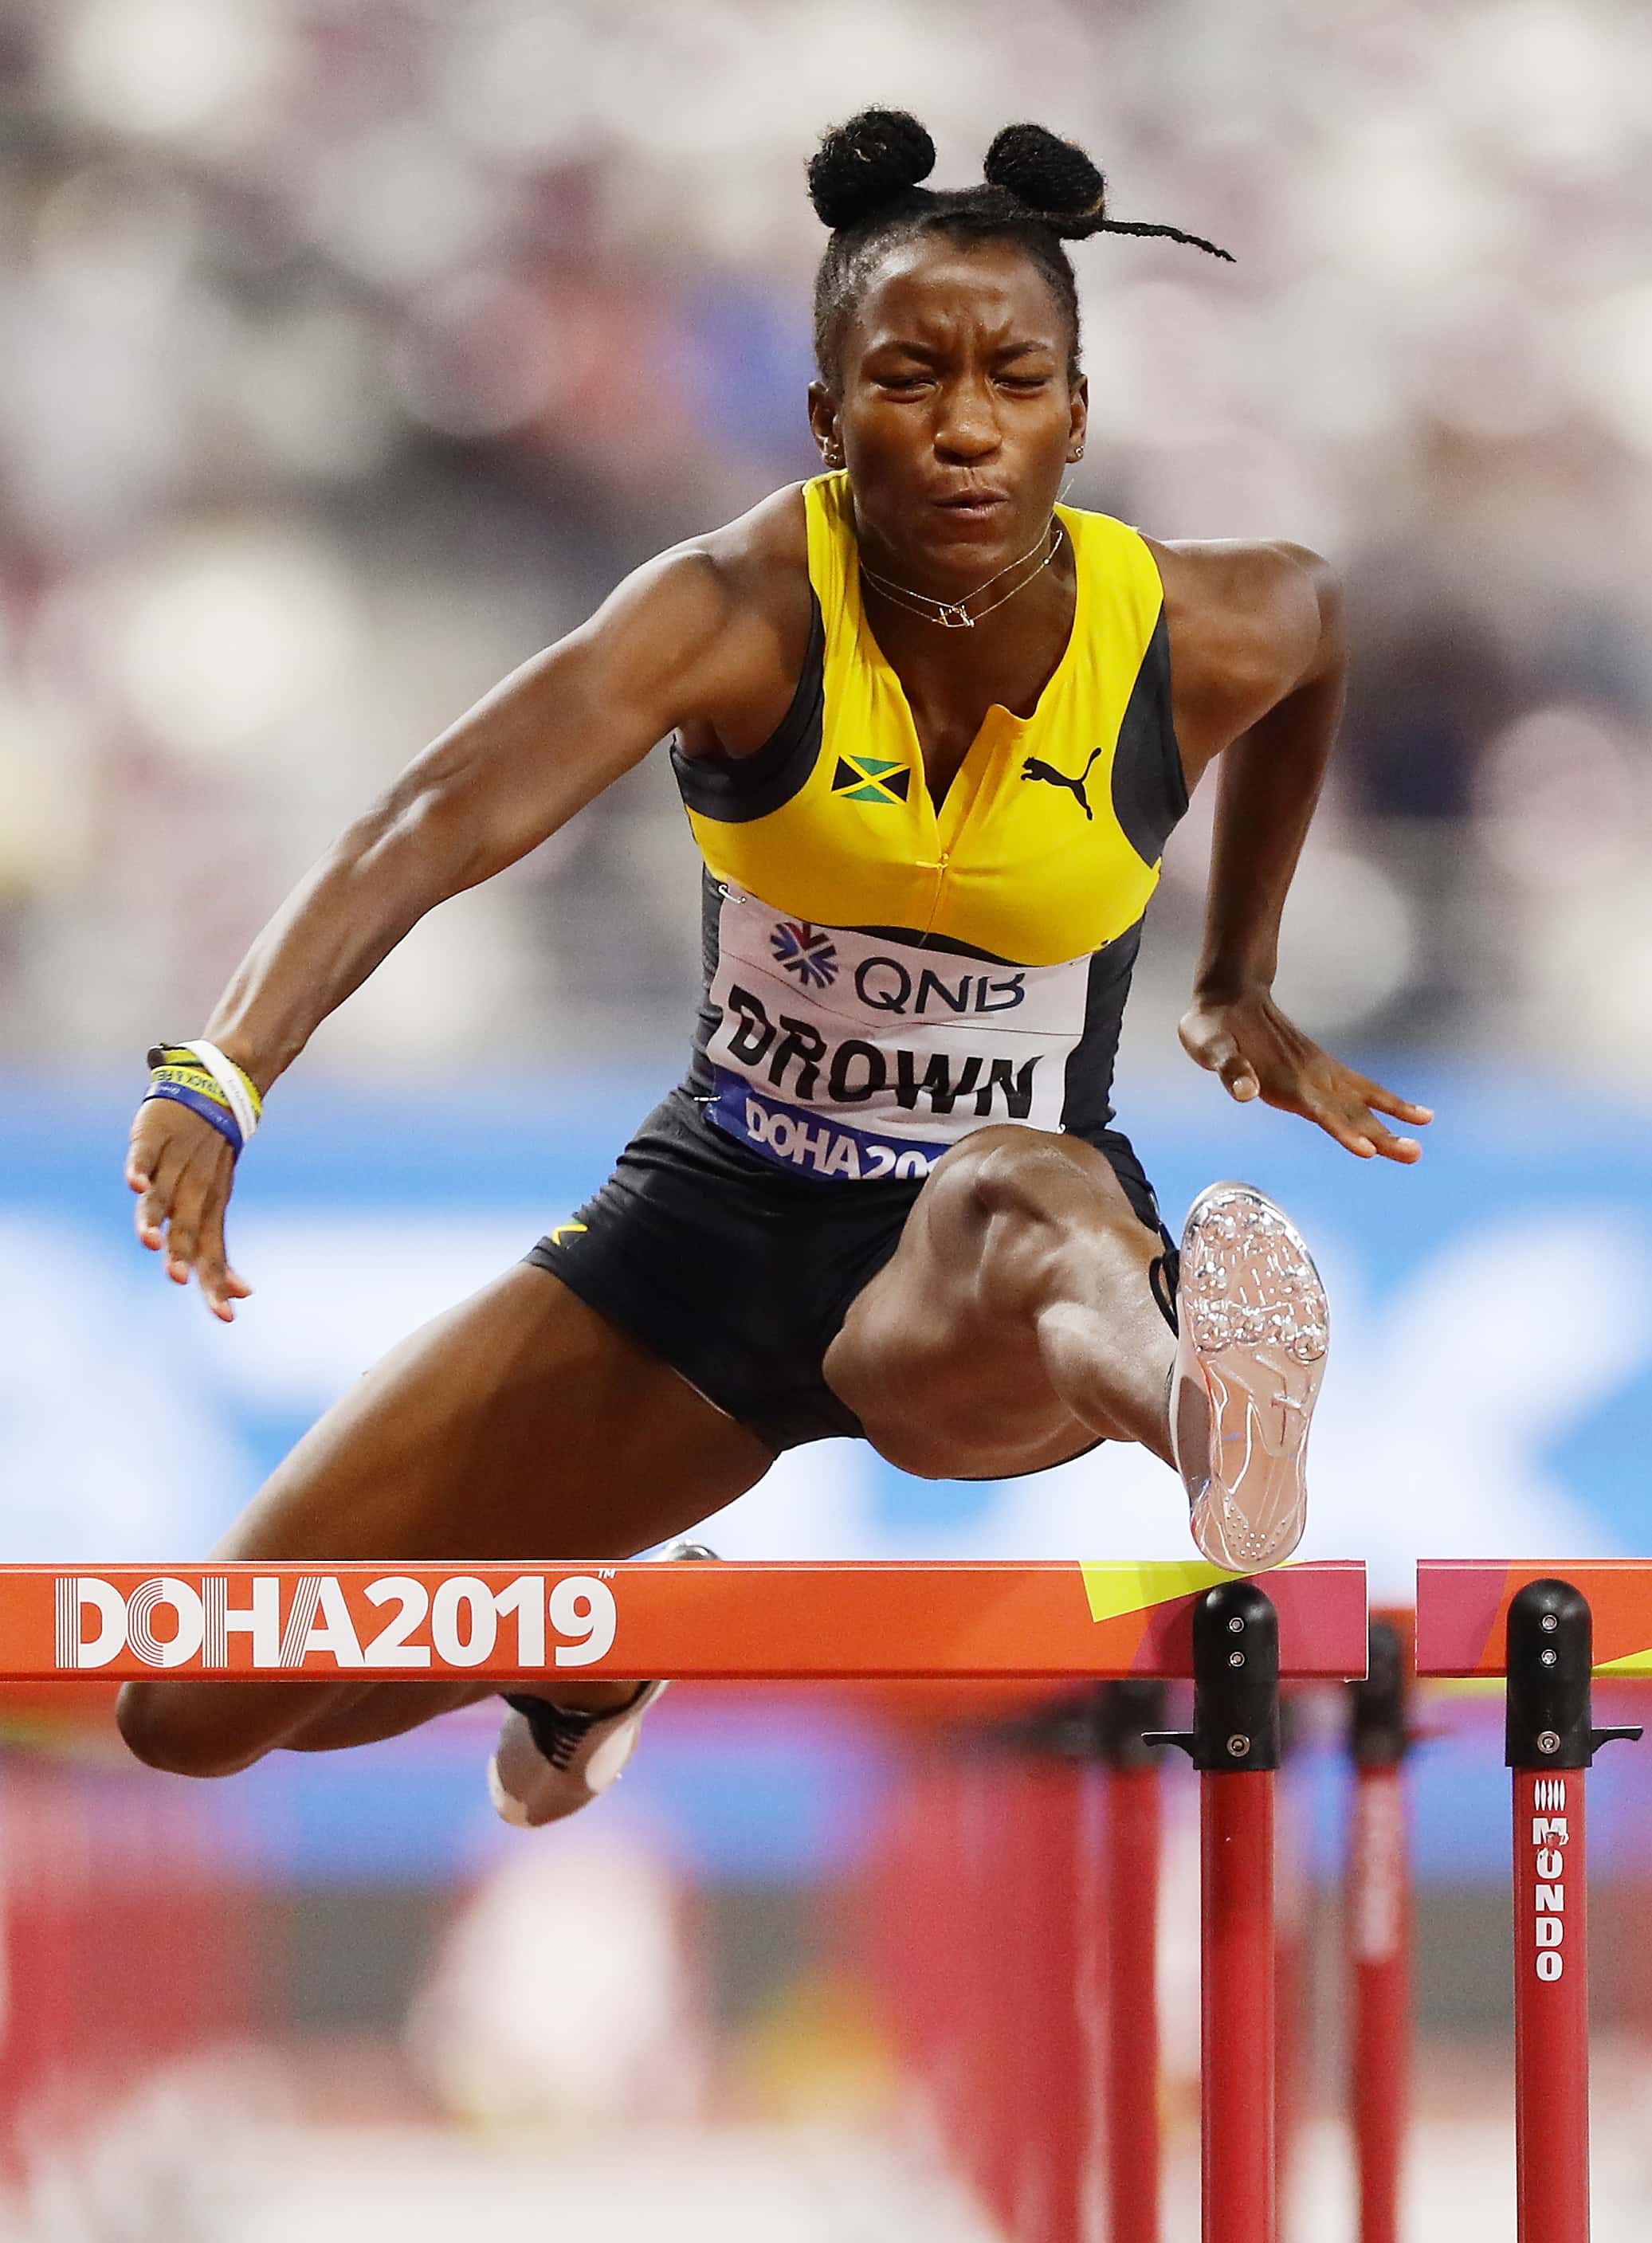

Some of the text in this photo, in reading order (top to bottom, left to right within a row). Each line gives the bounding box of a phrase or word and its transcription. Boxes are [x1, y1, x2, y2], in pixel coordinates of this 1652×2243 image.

[854, 956, 1026, 1014] QNB
[745, 1097, 940, 1180] DOHA20
[55, 1575, 618, 1669] DOHA2019
[1532, 1817, 1569, 1982] MONDO
